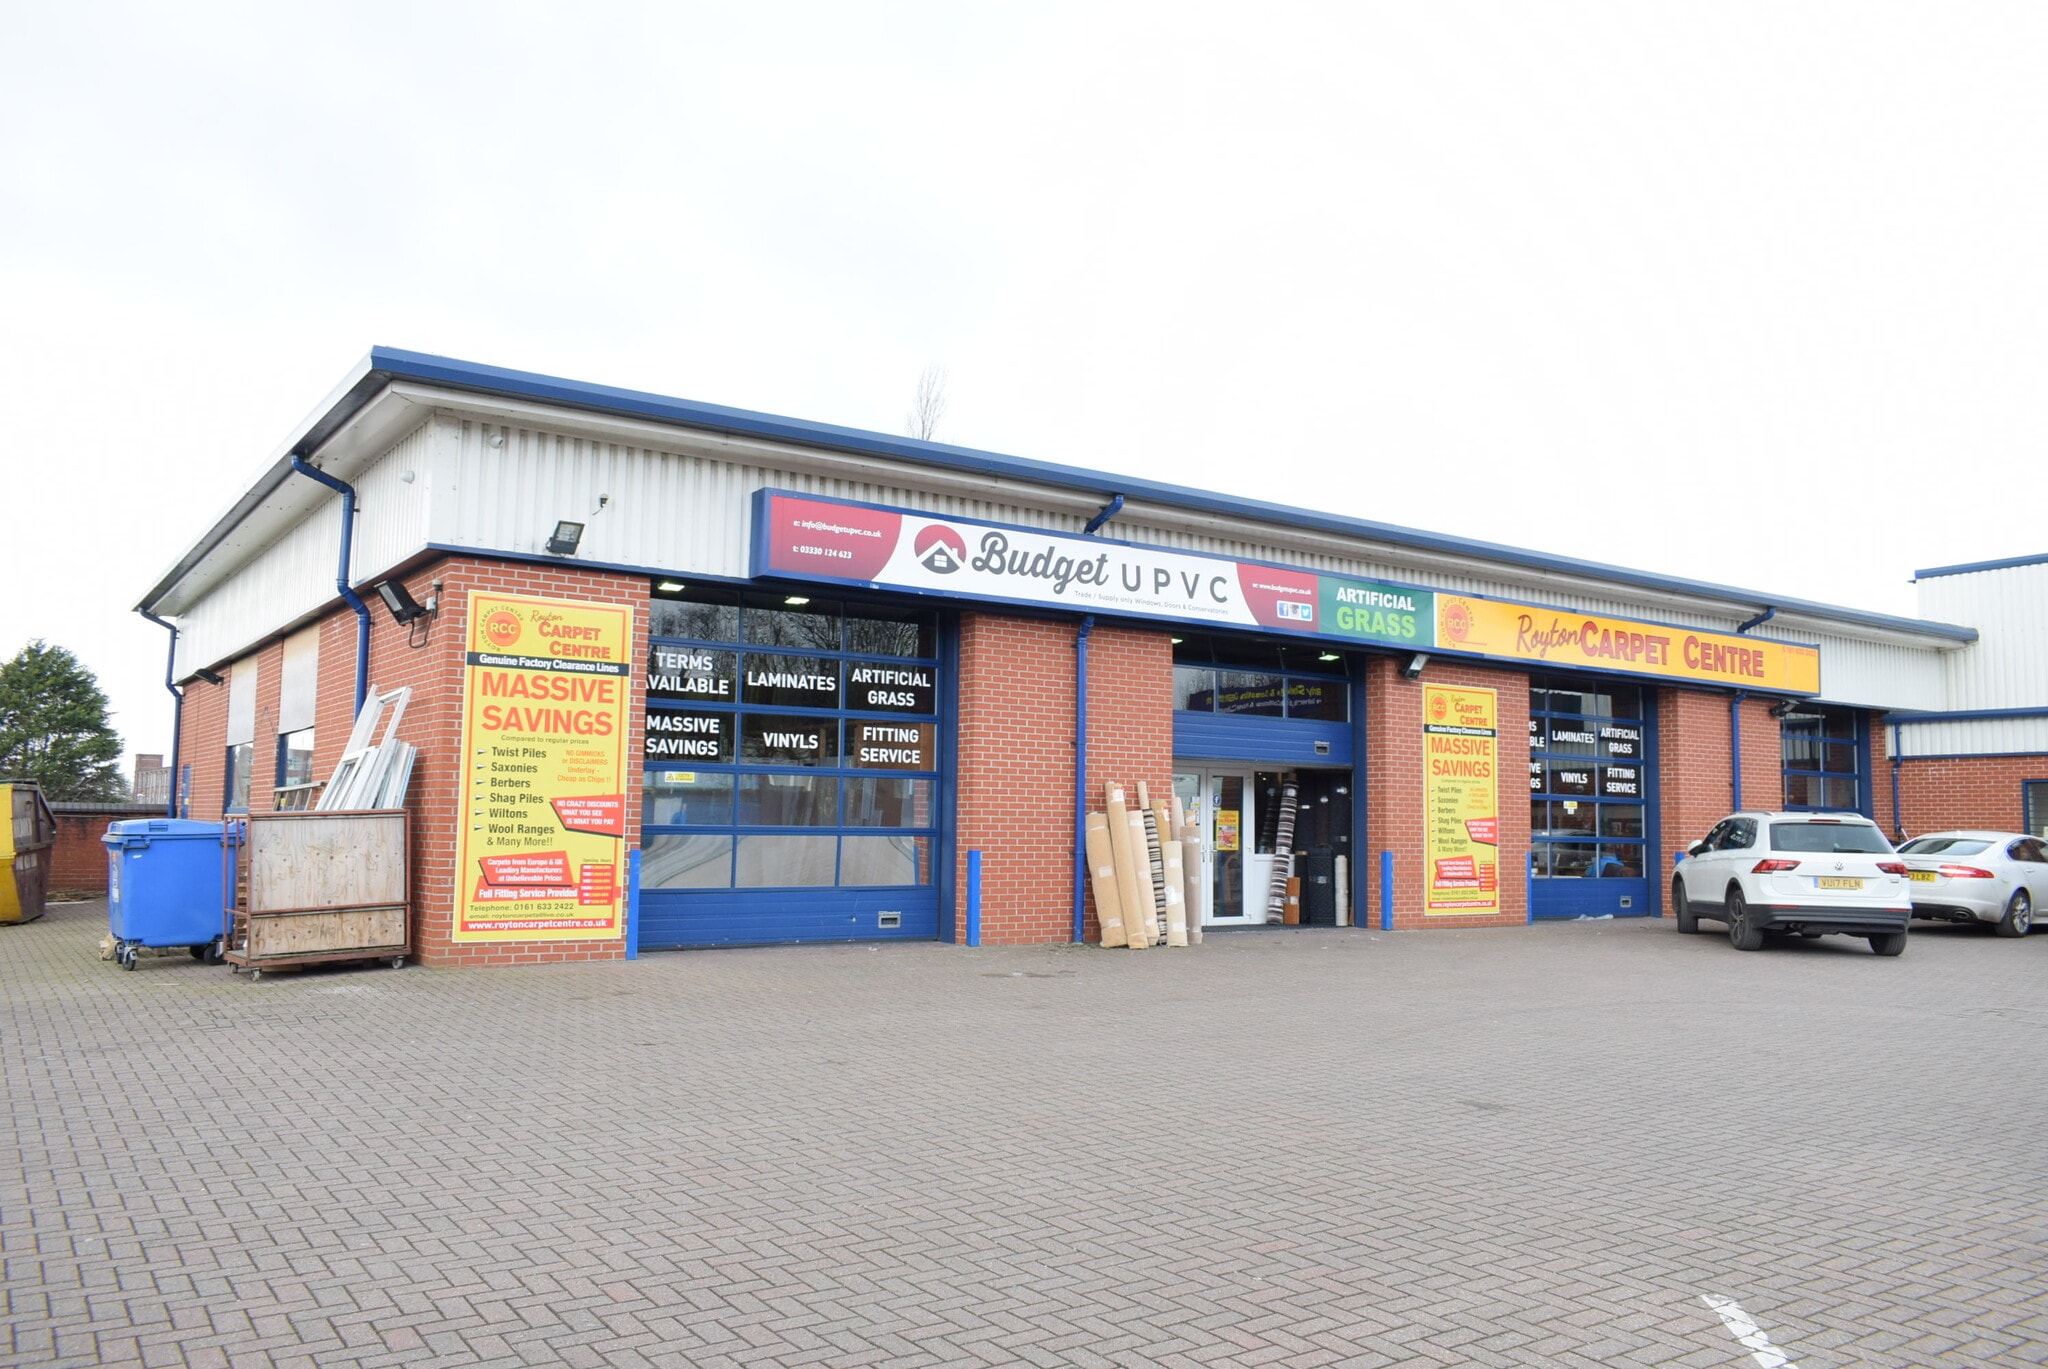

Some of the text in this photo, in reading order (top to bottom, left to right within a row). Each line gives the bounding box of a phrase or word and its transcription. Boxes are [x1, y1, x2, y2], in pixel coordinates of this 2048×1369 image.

[802, 520, 881, 537] info@budgetupvc.co.uk
[800, 546, 822, 555] 03330
[839, 550, 852, 558] 623
[972, 532, 1109, 594] Budget
[1099, 594, 1118, 603] Supply
[1120, 596, 1133, 604] only
[1188, 605, 1228, 615] Conservatories
[1336, 587, 1415, 611] ARTIFICIAL
[481, 606, 524, 627] CARPET CENTRE
[531, 610, 564, 622] Royton
[490, 623, 517, 634] RCC
[1337, 607, 1416, 638] GRASS
[1450, 618, 1465, 630] RCC
[538, 622, 601, 640] CARPET
[550, 641, 610, 659] CENTRE
[1517, 614, 1765, 678] Royton CARPET CENTRE
[479, 654, 619, 673] Genuine Factory Clearance Lines
[656, 652, 713, 671] TERMS
[748, 671, 836, 691] LAMINATES
[852, 668, 931, 688] ARTIFICIAL
[482, 672, 614, 704] MASSIVE
[867, 690, 915, 707] GRASS
[1455, 702, 1483, 714] CARPET
[482, 705, 613, 736] SAVINGS
[646, 715, 720, 734] MASSIVE
[1460, 715, 1488, 726] CENTRE
[501, 735, 535, 743] Compared
[537, 735, 544, 743] to
[546, 736, 568, 744] regular
[863, 727, 919, 743] FITTING
[1552, 730, 1594, 743] LAMINATES
[1601, 727, 1639, 740] ARTIFICIAL
[763, 732, 819, 749] VINYLS
[1431, 737, 1490, 756] MASSIVE
[492, 746, 546, 758] Twist Piles
[645, 738, 718, 756] SAVINGS
[1609, 742, 1632, 754] GRASS
[860, 748, 920, 764] SERVICE
[491, 762, 538, 773] Saxonies
[1432, 759, 1491, 778] SAVINGS
[1607, 768, 1635, 779] FITTING
[491, 778, 530, 788] Berbers
[558, 775, 577, 783] Cheap
[1561, 772, 1588, 784] VINYLS
[1606, 782, 1636, 794] SERVICE
[490, 793, 544, 805] Shag Piles
[489, 808, 528, 818] Wiltons
[1438, 817, 1449, 825] Shag
[489, 824, 554, 836] Wool Ranges
[487, 837, 553, 847] & Many More!!
[487, 858, 511, 866] Carpets
[495, 867, 519, 875] Leading
[1822, 878, 1861, 888] VU17 FLN
[479, 888, 577, 899] Full Fitting Service Provided
[514, 903, 534, 911] 0161
[468, 919, 607, 930] www.roytoncarpetcentre.co.uk
